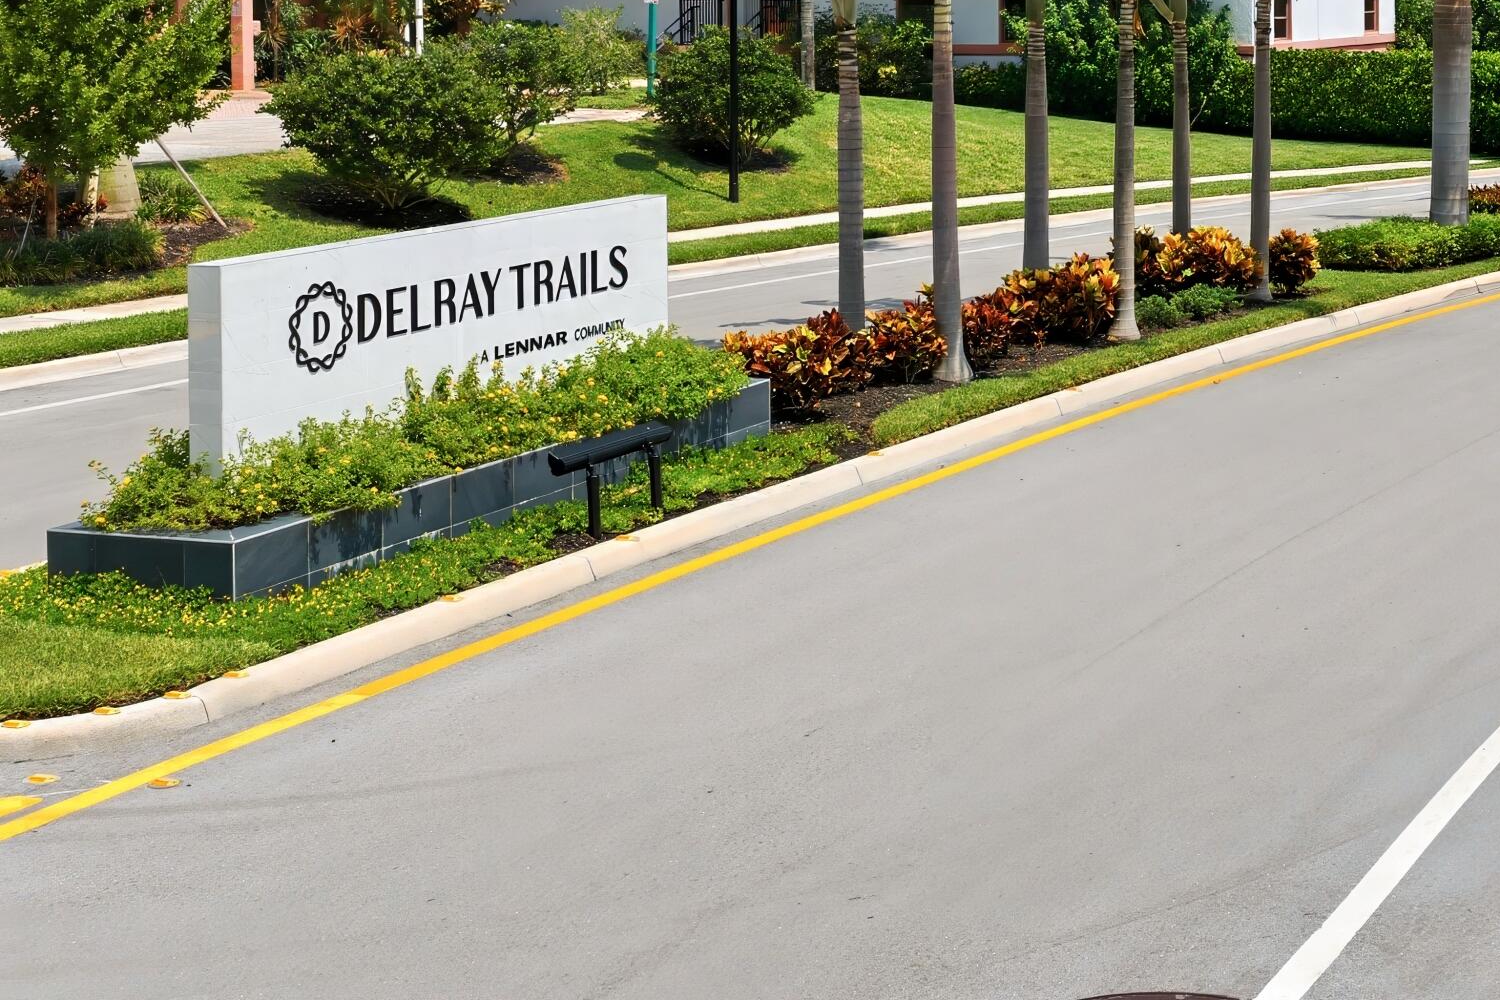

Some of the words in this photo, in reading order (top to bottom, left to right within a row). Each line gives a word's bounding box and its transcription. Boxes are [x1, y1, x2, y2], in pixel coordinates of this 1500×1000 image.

[357, 268, 502, 344] DELRAY
[509, 246, 629, 311] TRAILS
[313, 311, 330, 344] D
[480, 349, 489, 364] A
[494, 331, 568, 360] LENNAR
